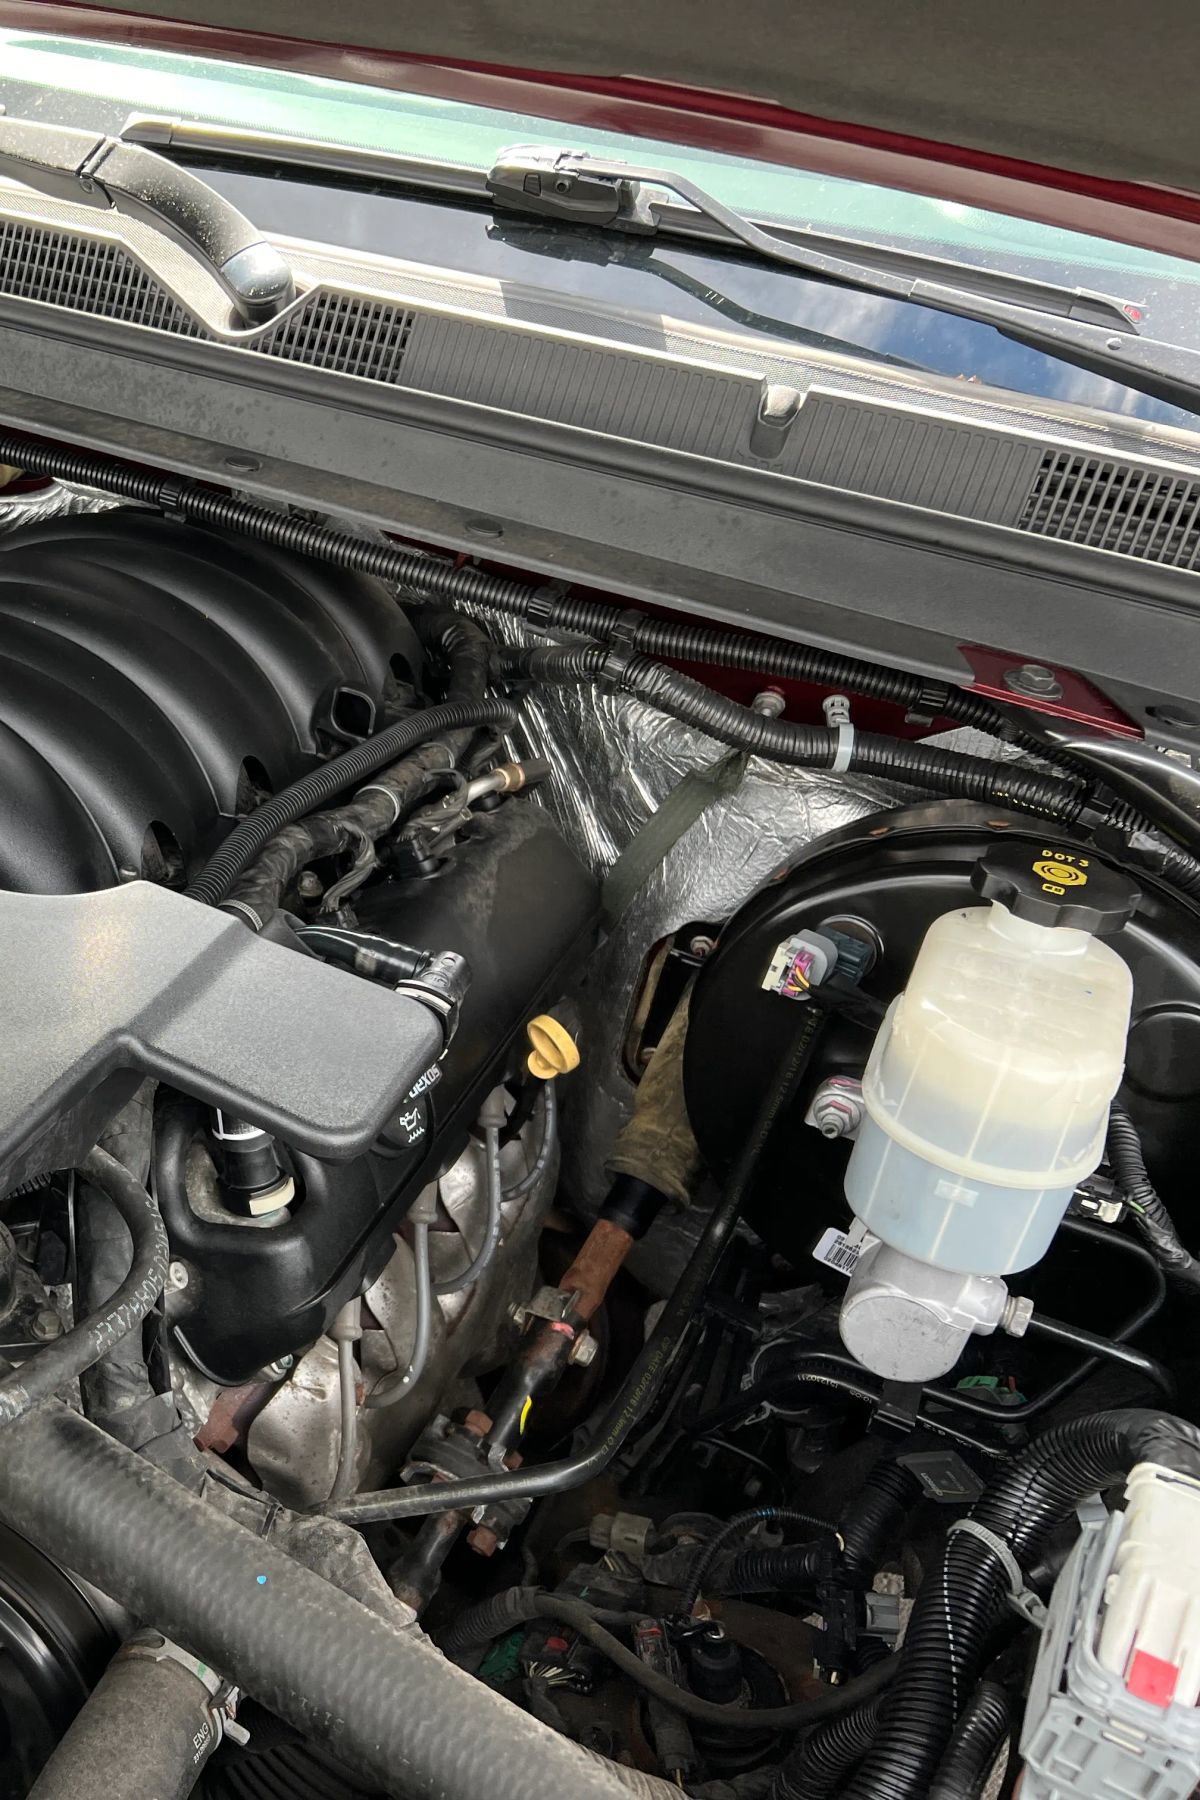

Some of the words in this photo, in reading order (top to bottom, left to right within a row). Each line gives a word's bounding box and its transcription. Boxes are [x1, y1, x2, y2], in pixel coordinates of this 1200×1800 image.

[1041, 849, 1076, 863] DOT
[1079, 859, 1089, 867] 3
[192, 1722, 209, 1749] ENG
